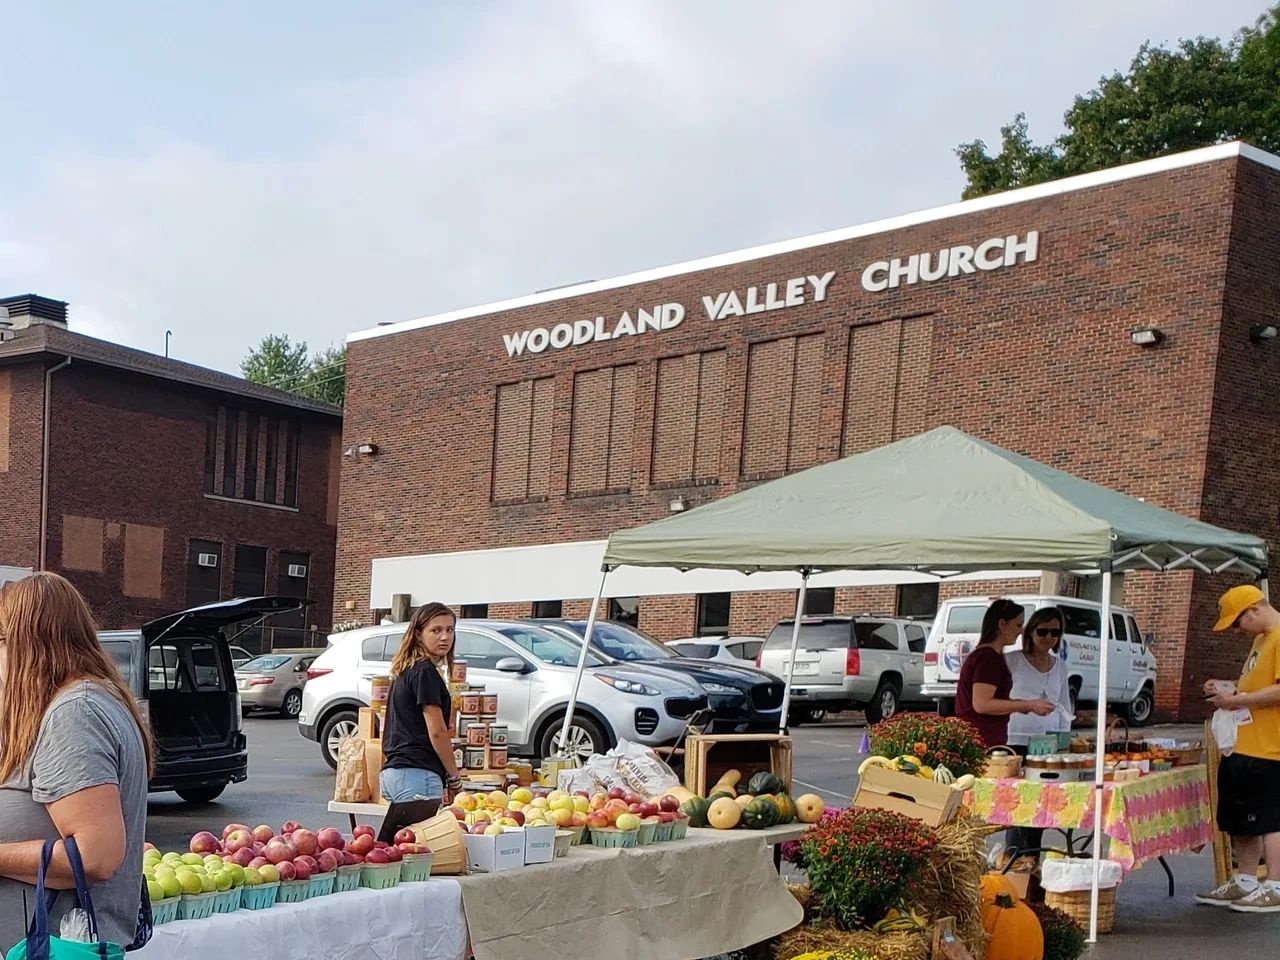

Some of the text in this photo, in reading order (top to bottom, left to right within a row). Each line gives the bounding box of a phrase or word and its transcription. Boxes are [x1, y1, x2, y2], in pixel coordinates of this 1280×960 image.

[502, 230, 1040, 358] WOODLAND VALLEY CHURCH
